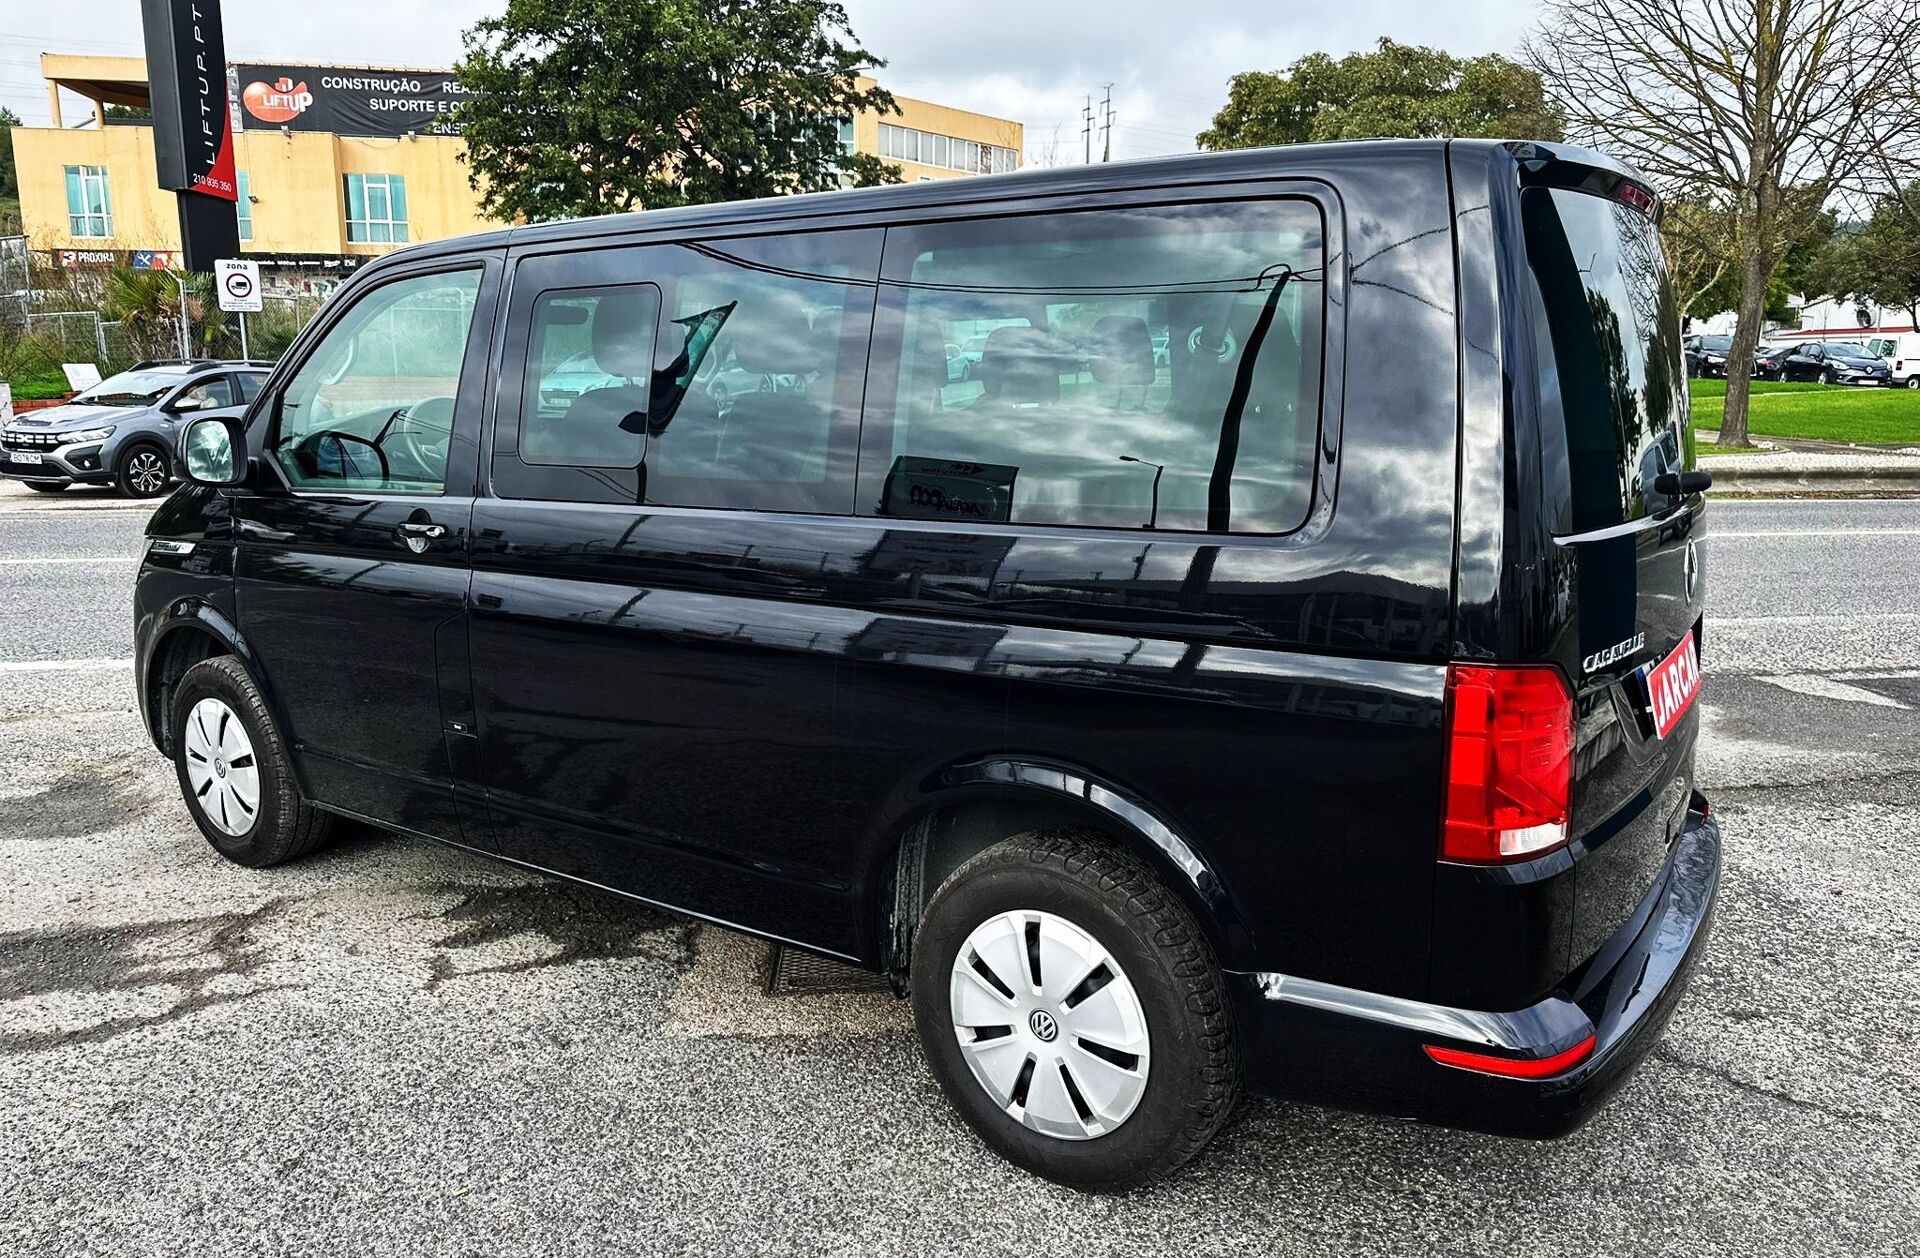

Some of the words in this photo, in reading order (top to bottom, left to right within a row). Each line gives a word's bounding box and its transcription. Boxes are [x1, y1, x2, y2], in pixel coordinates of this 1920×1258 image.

[192, 3, 216, 166] LIFTUP.PT
[321, 76, 421, 95] CONSTRUÇÃO
[369, 98, 436, 113] SUPORTE
[438, 101, 447, 113] E
[193, 173, 206, 185] 210
[1582, 632, 1645, 674] CARAVELLE
[1658, 639, 1700, 729] JARCAR
